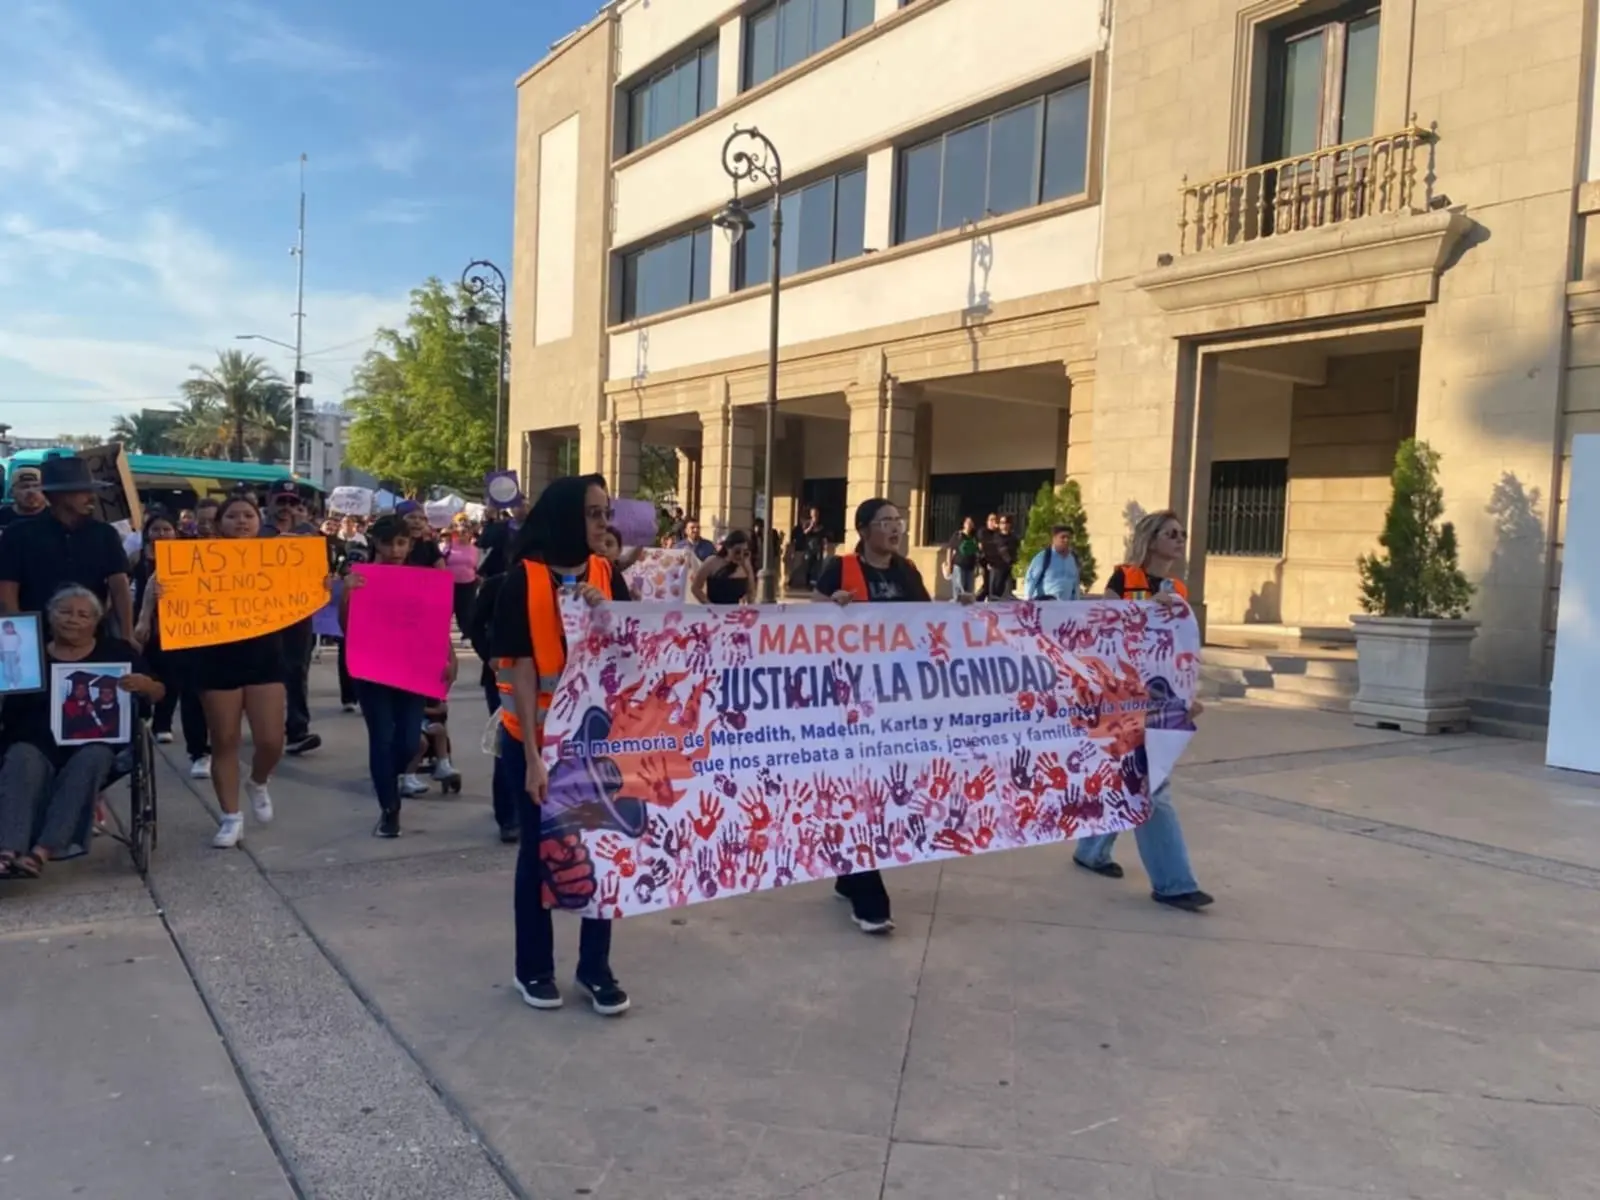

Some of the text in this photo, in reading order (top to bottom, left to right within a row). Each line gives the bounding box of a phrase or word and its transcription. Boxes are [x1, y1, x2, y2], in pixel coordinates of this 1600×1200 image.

[167, 542, 305, 575] LAS Y LOS
[167, 598, 189, 619] NO
[194, 598, 223, 618] SE
[288, 591, 309, 607] NO
[165, 621, 220, 638] VIOLAN
[758, 621, 1008, 655] MARCHA X LA
[716, 654, 1057, 713] JUSTICIA Y LA DIGNIDAD
[562, 739, 584, 755] En
[592, 735, 676, 754] memoria
[683, 731, 704, 749] de
[711, 724, 796, 746] Meredith,
[881, 716, 928, 733] Karla
[934, 717, 943, 732] y
[949, 707, 1030, 727] Margarita
[1035, 709, 1044, 723] y
[1102, 701, 1114, 713] la
[692, 757, 724, 776] que
[730, 755, 760, 770] nos
[766, 747, 839, 767] arrebata
[845, 748, 854, 759] a
[860, 738, 942, 758] infancias,
[1012, 731, 1021, 746] y
[1027, 724, 1088, 742] familias
